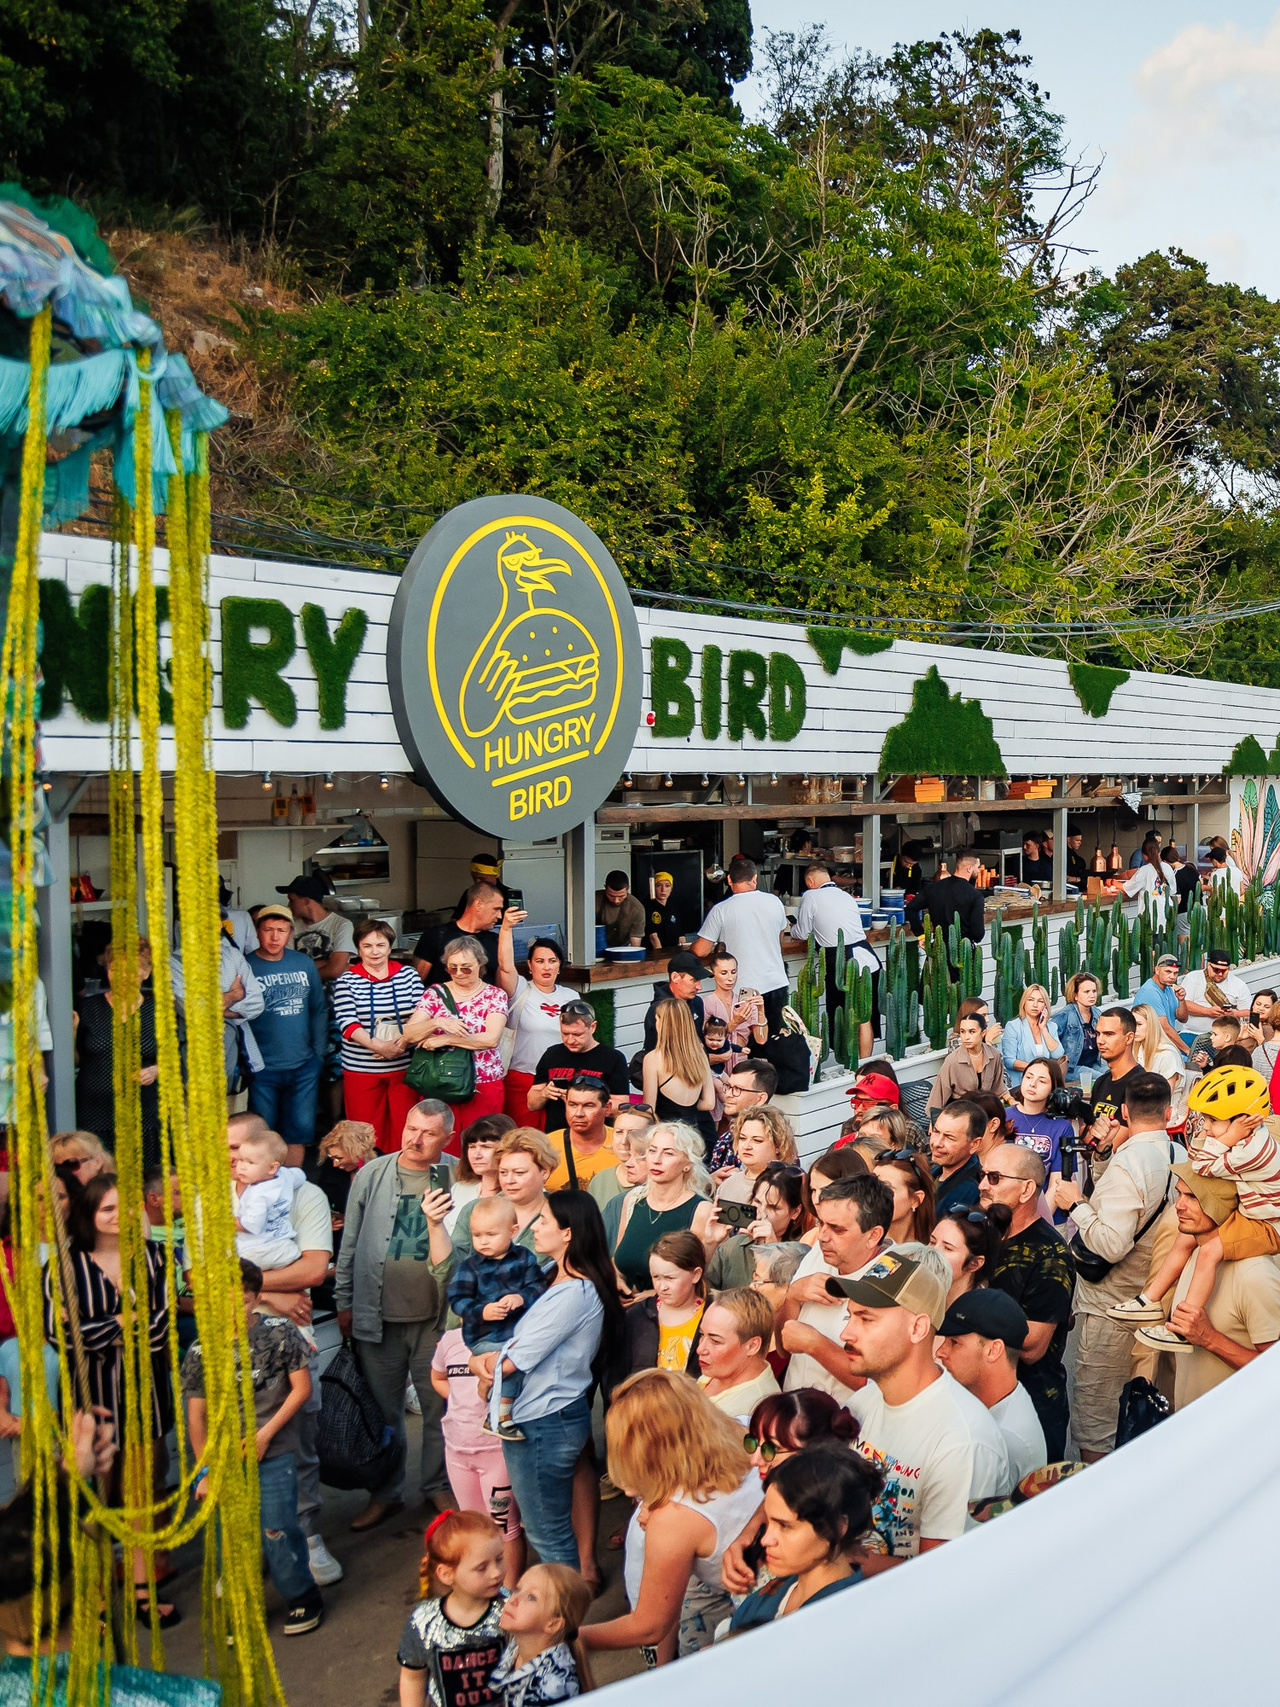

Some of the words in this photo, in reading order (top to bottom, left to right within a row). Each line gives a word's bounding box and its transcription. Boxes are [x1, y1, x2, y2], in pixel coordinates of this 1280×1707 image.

[650, 636, 807, 741] BIRD
[484, 711, 596, 773] HUNGRY
[508, 774, 572, 822] BIRD
[256, 971, 310, 992] SUPERIOR
[442, 1648, 498, 1671] DANCE
[461, 1670, 485, 1689] IT
[456, 1688, 492, 1706] OUT
